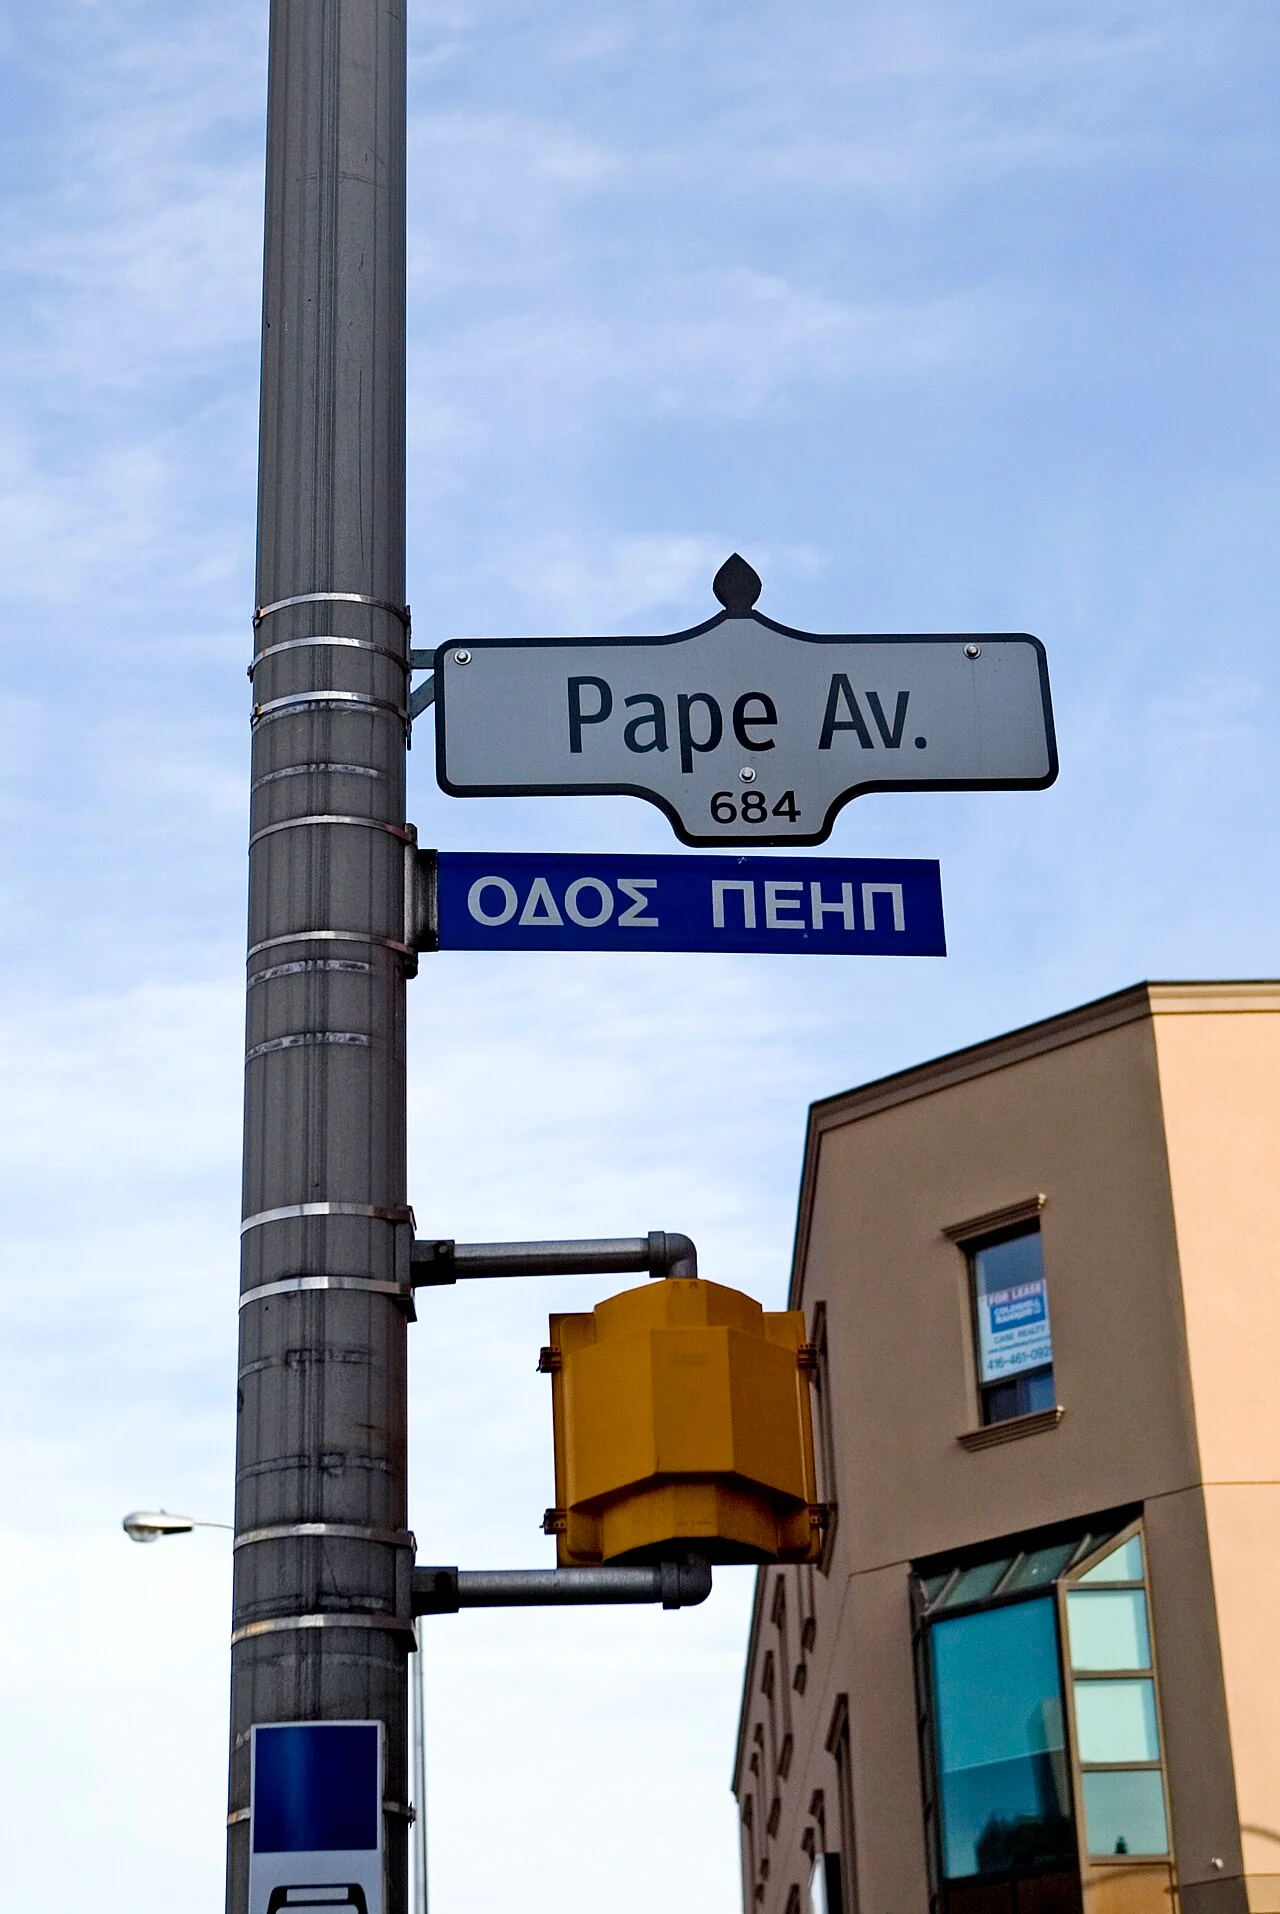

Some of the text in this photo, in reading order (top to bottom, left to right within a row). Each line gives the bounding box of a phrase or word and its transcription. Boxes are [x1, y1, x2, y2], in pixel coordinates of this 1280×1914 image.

[567, 672, 928, 774] Pape Av.
[710, 790, 801, 824] 684
[467, 874, 907, 931] ΟΔΟΣ ΠΕΗΠ
[988, 1282, 1041, 1305] FOR LEASE
